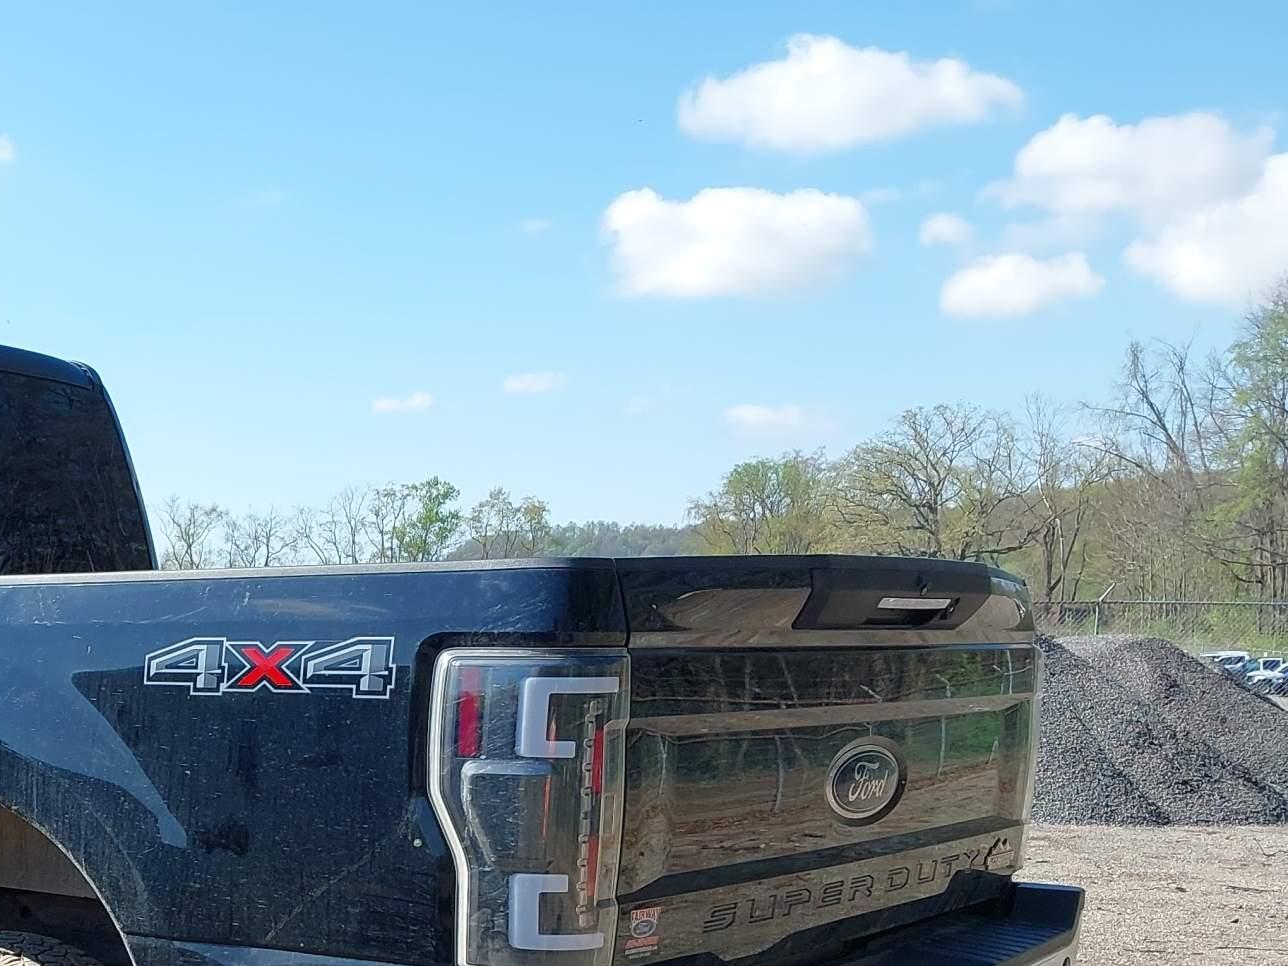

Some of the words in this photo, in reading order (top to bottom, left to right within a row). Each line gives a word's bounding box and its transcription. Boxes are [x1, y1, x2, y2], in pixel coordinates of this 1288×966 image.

[848, 761, 889, 802] Ford
[702, 873, 875, 934] SUPER
[887, 848, 982, 893] DUTY
